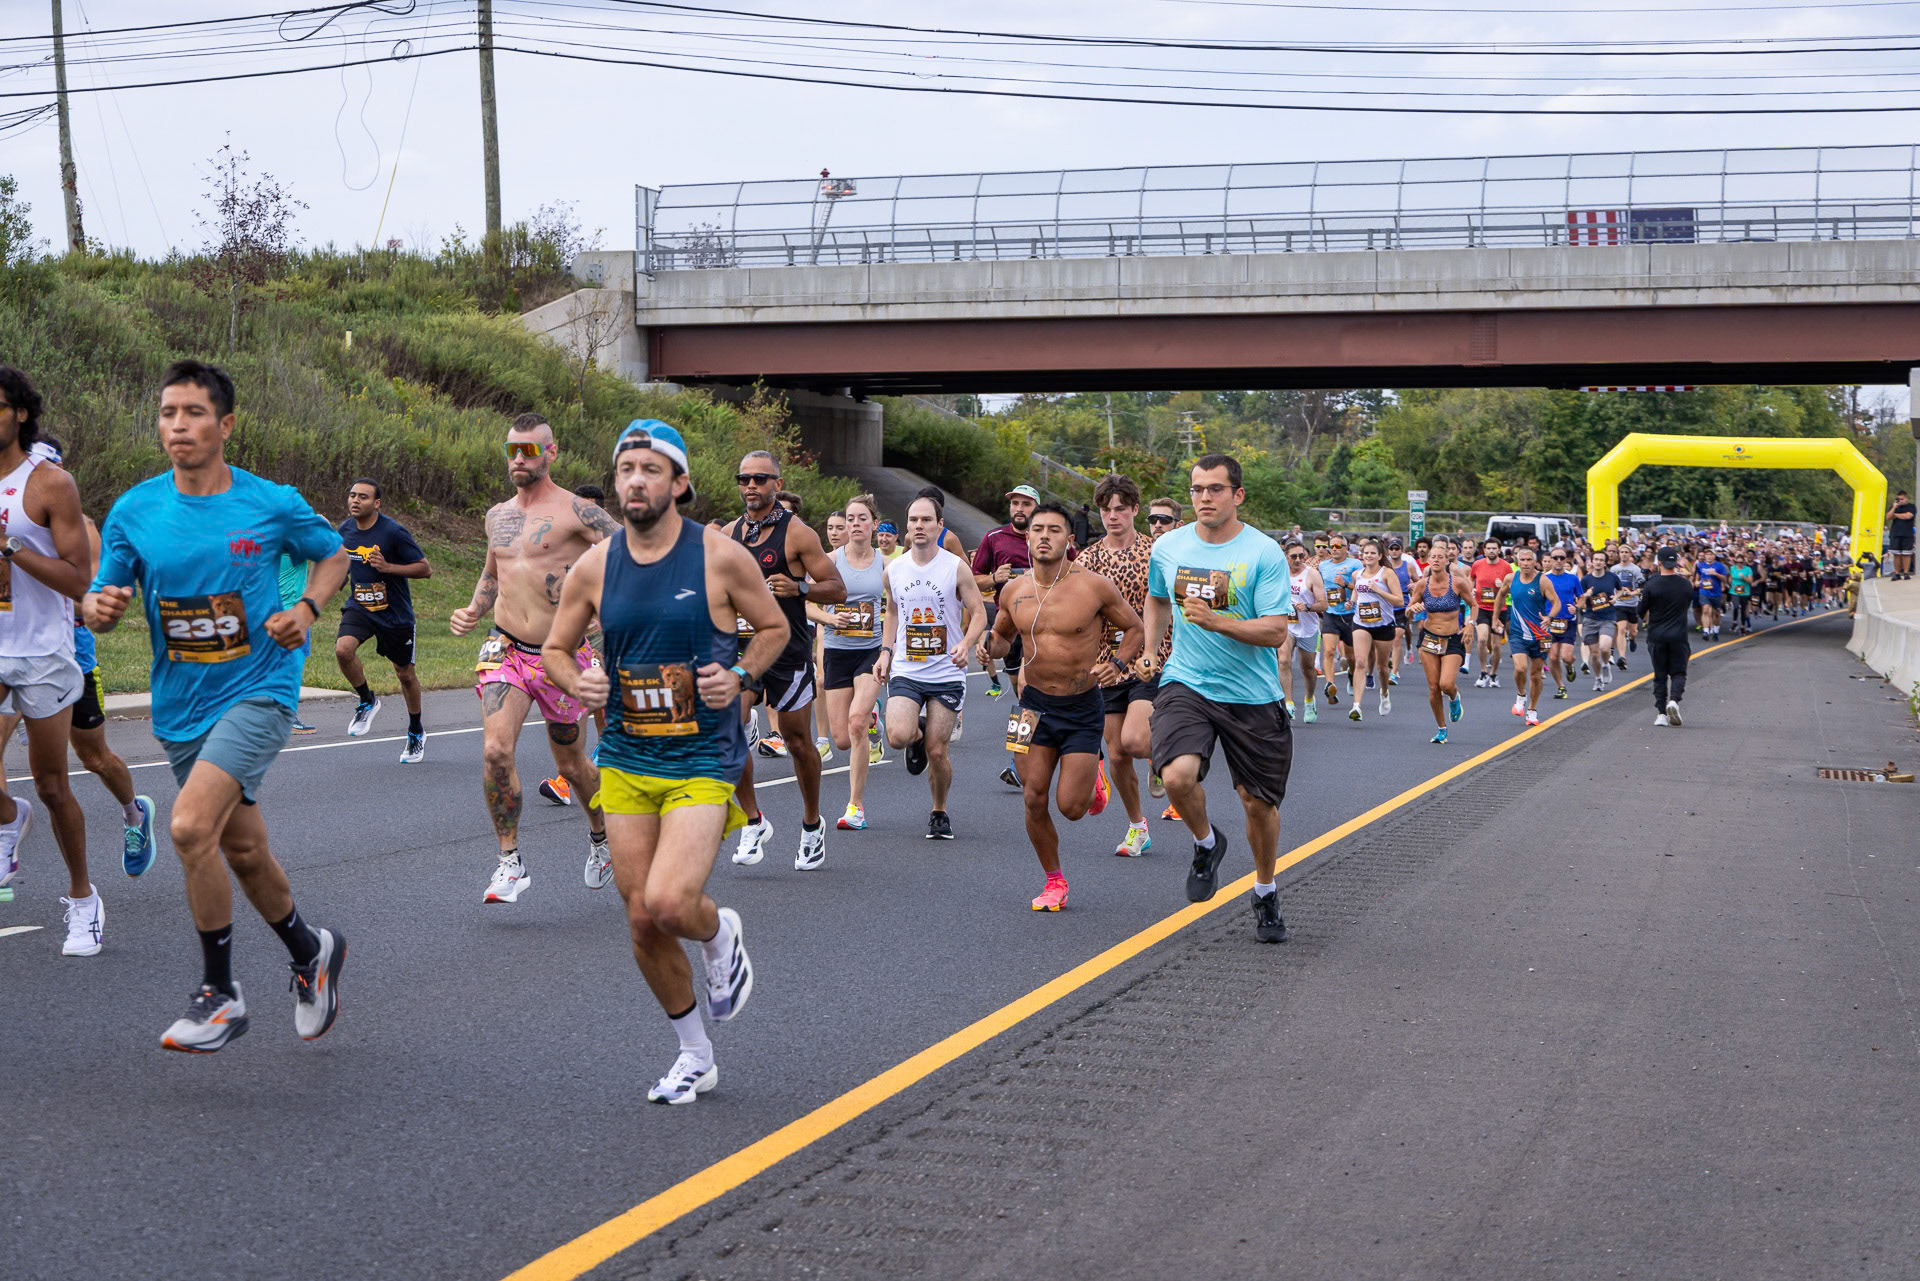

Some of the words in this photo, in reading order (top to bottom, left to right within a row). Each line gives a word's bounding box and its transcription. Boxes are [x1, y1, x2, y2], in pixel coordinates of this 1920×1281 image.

[1415, 531, 1420, 539] 2
[356, 591, 384, 602] 363
[904, 579, 921, 592] RAD
[926, 580, 945, 621] RUNNERS
[1185, 583, 1216, 600] 55
[167, 615, 240, 638] 233
[911, 637, 942, 649] 212
[631, 688, 673, 709] 111
